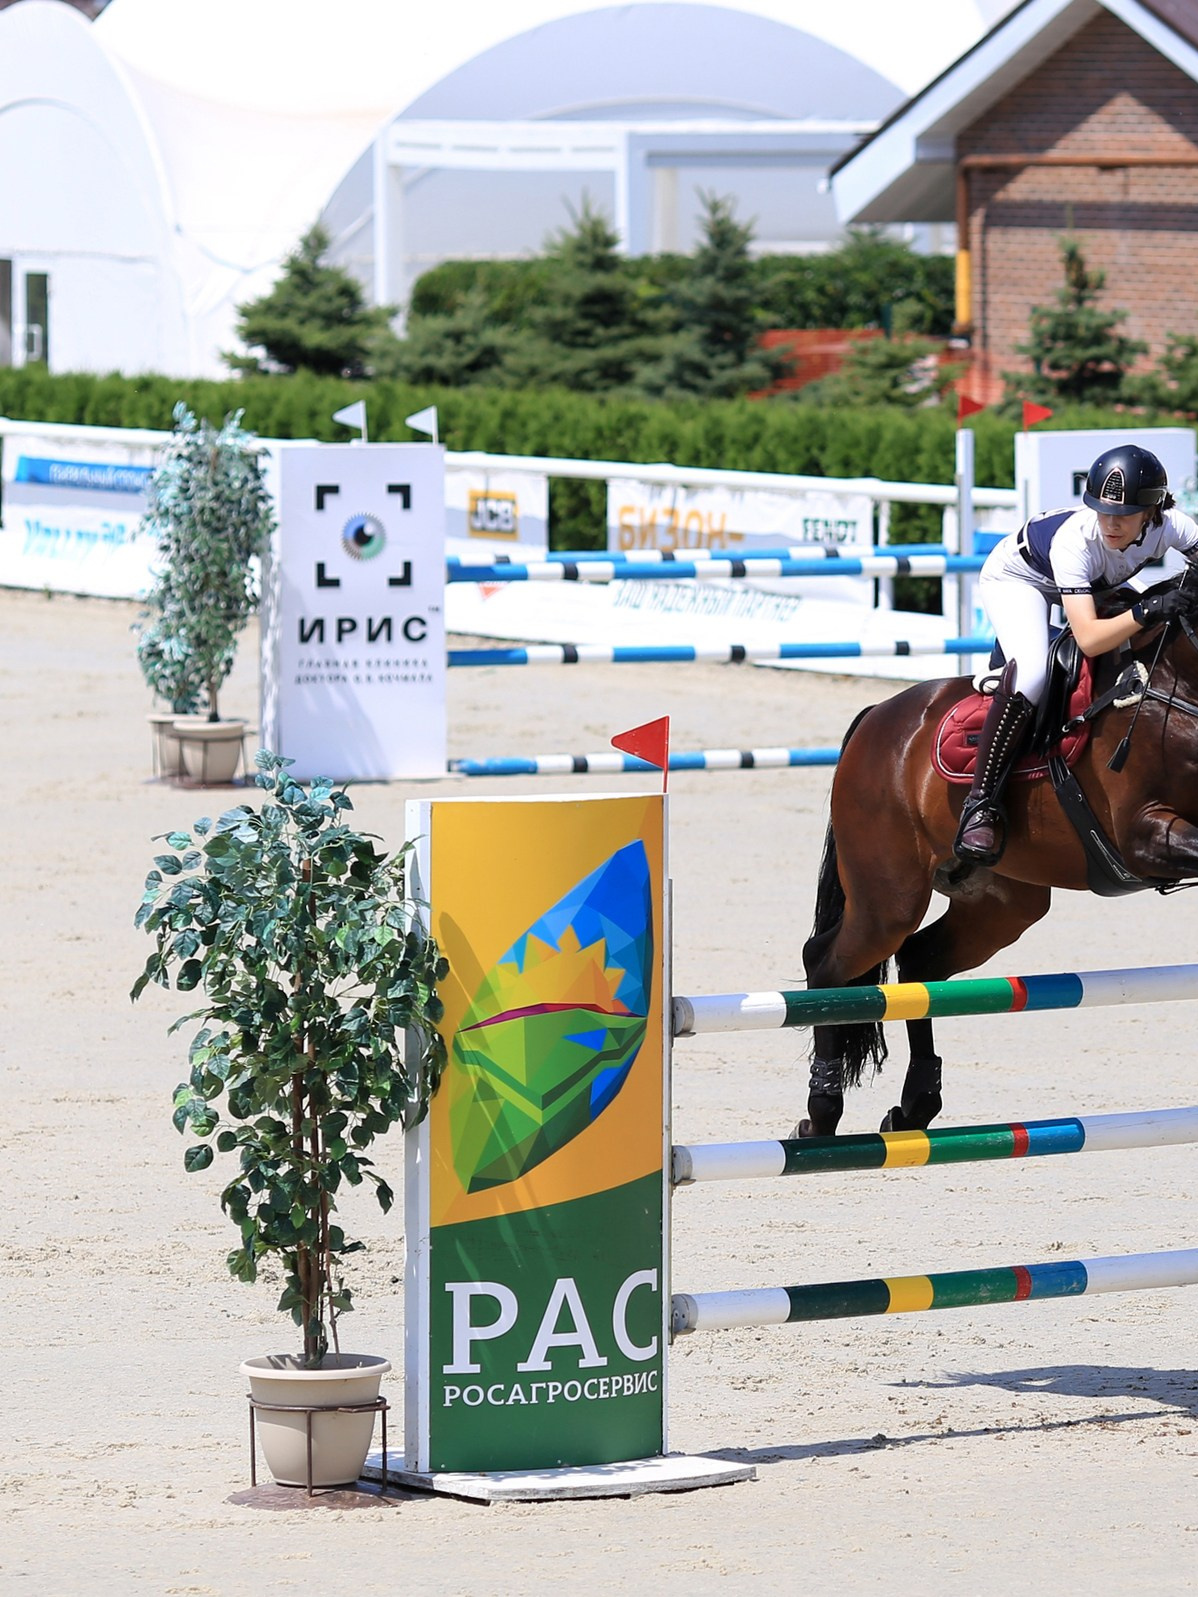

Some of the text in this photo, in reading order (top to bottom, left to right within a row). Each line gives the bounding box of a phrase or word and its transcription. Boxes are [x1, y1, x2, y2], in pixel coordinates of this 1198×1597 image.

[473, 497, 515, 533] JCB
[802, 517, 858, 543] FENDT
[298, 615, 428, 643] ИРИС
[442, 1268, 658, 1374] РАС
[442, 1370, 658, 1407] РОСАГРОСЕРВИС
